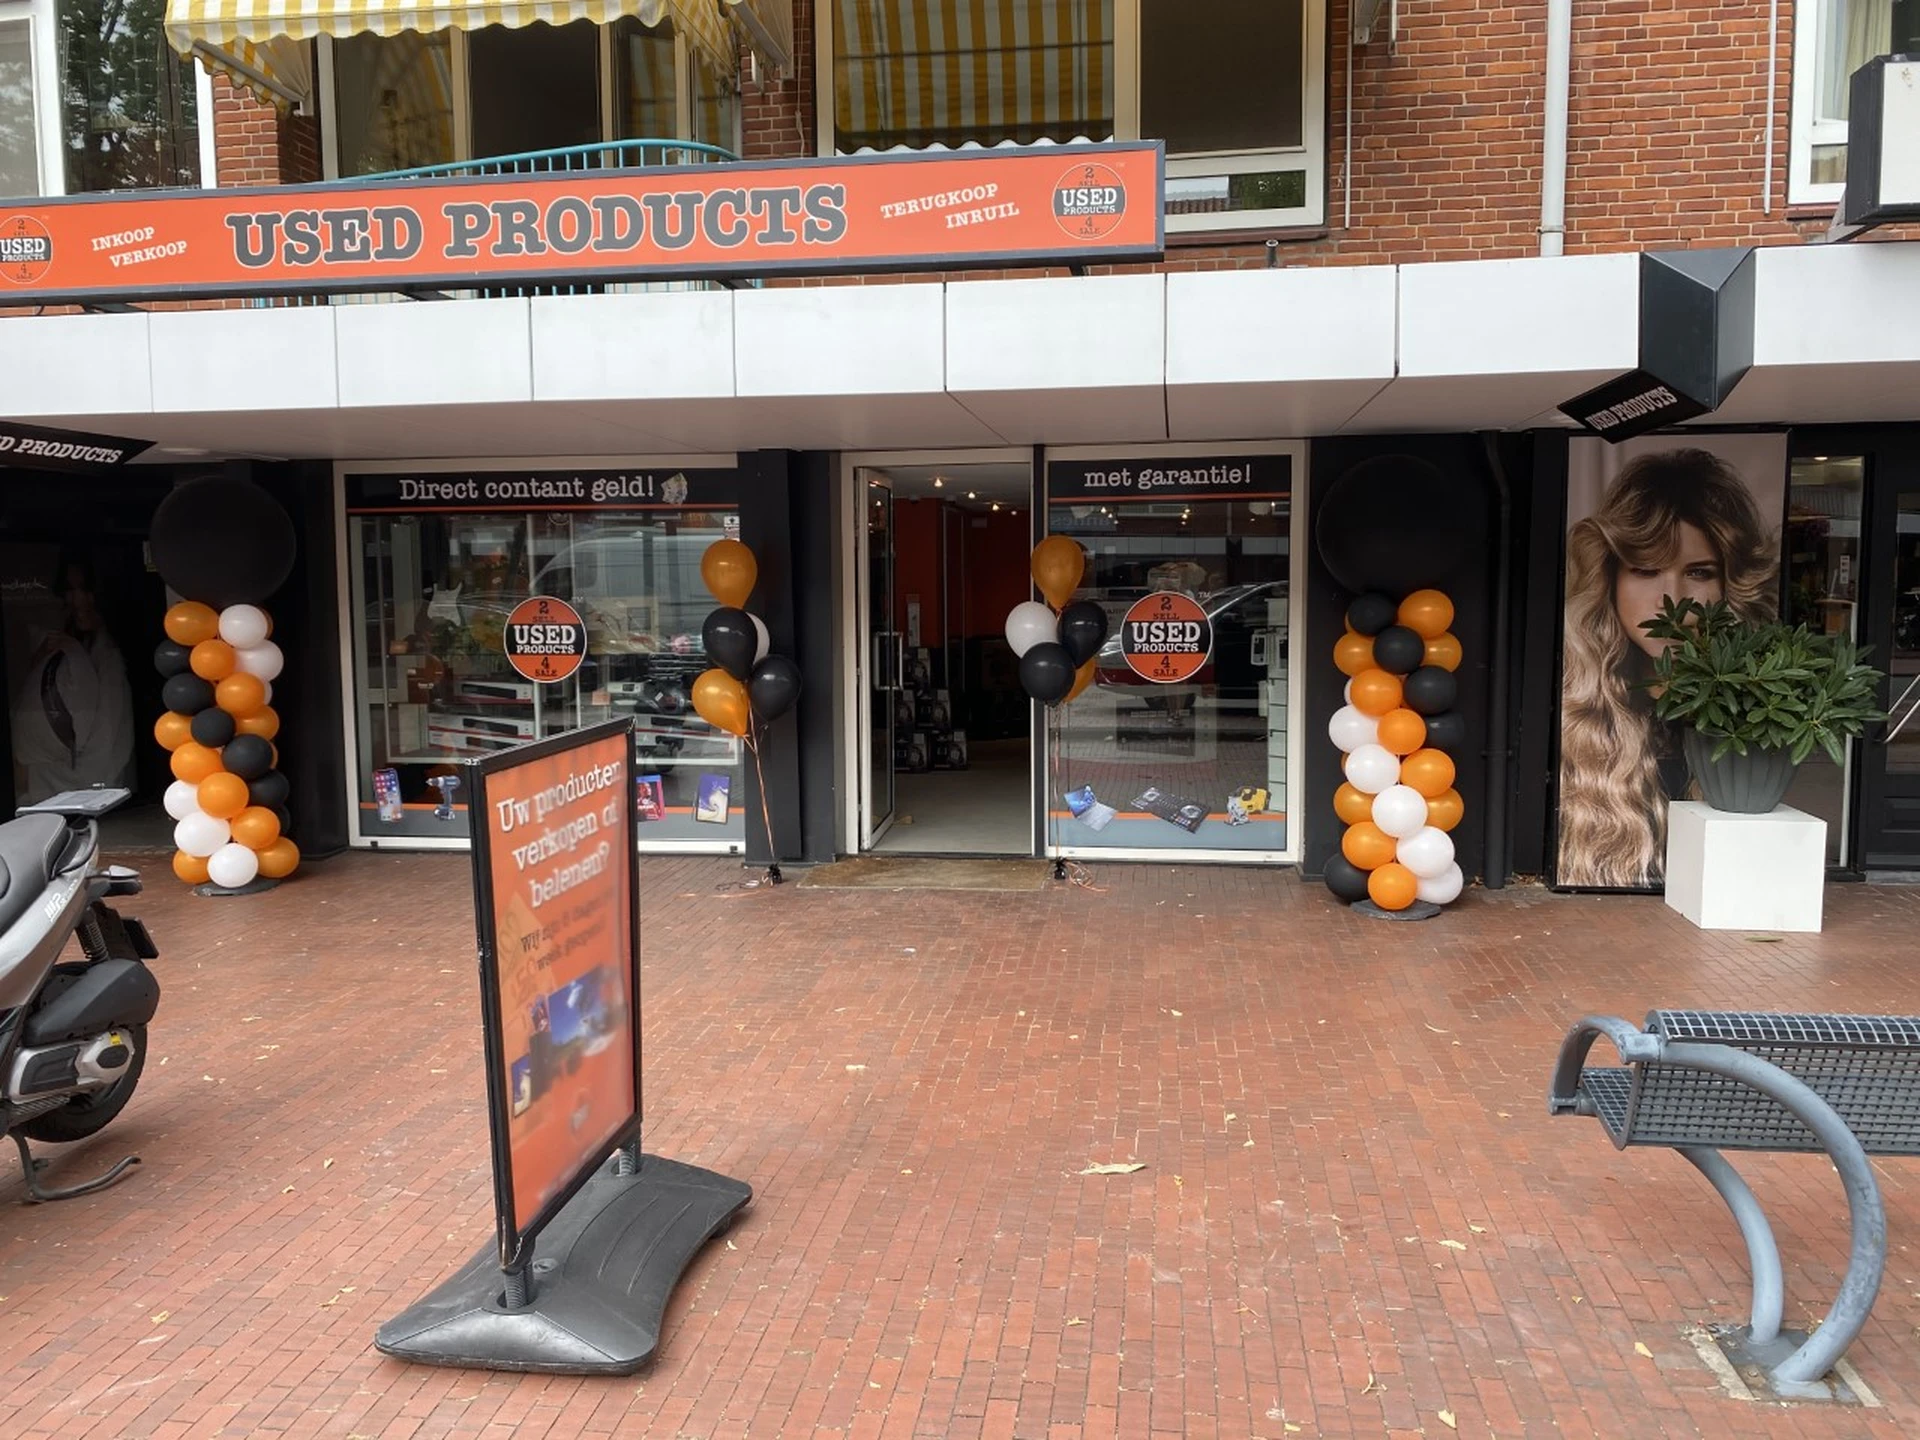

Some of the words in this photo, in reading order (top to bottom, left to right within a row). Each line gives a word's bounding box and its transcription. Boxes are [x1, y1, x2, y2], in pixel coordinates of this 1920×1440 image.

[880, 183, 999, 219] TERUGKOOP
[1061, 187, 1117, 207] USED
[945, 202, 1020, 229] INRUIL
[1063, 205, 1116, 215] PRODUCTS
[225, 205, 424, 269] USED
[442, 183, 848, 260] PRODUCTS
[0, 238, 45, 254] USED
[91, 227, 155, 251] INKOOP
[109, 241, 188, 268] VERKOOP
[1585, 409, 1620, 431] USED
[1609, 385, 1678, 422] PRODUCTS
[13, 438, 123, 463] PRODUCTS
[1084, 468, 1131, 487] met
[1138, 464, 1251, 490] garantie!
[400, 478, 478, 500] Direct
[484, 477, 585, 499] contant
[590, 475, 654, 501] geld!
[540, 600, 549, 614] 2
[1160, 596, 1172, 611] 2
[513, 625, 576, 644] USED
[1131, 622, 1201, 643] USED
[516, 644, 575, 654] PRODUCTS
[1133, 643, 1199, 653] PRODUCTS
[541, 656, 550, 669] 4
[1160, 655, 1170, 668] 4
[1152, 669, 1179, 677] SALE
[496, 797, 530, 832] Uw
[512, 812, 600, 871] verkopen
